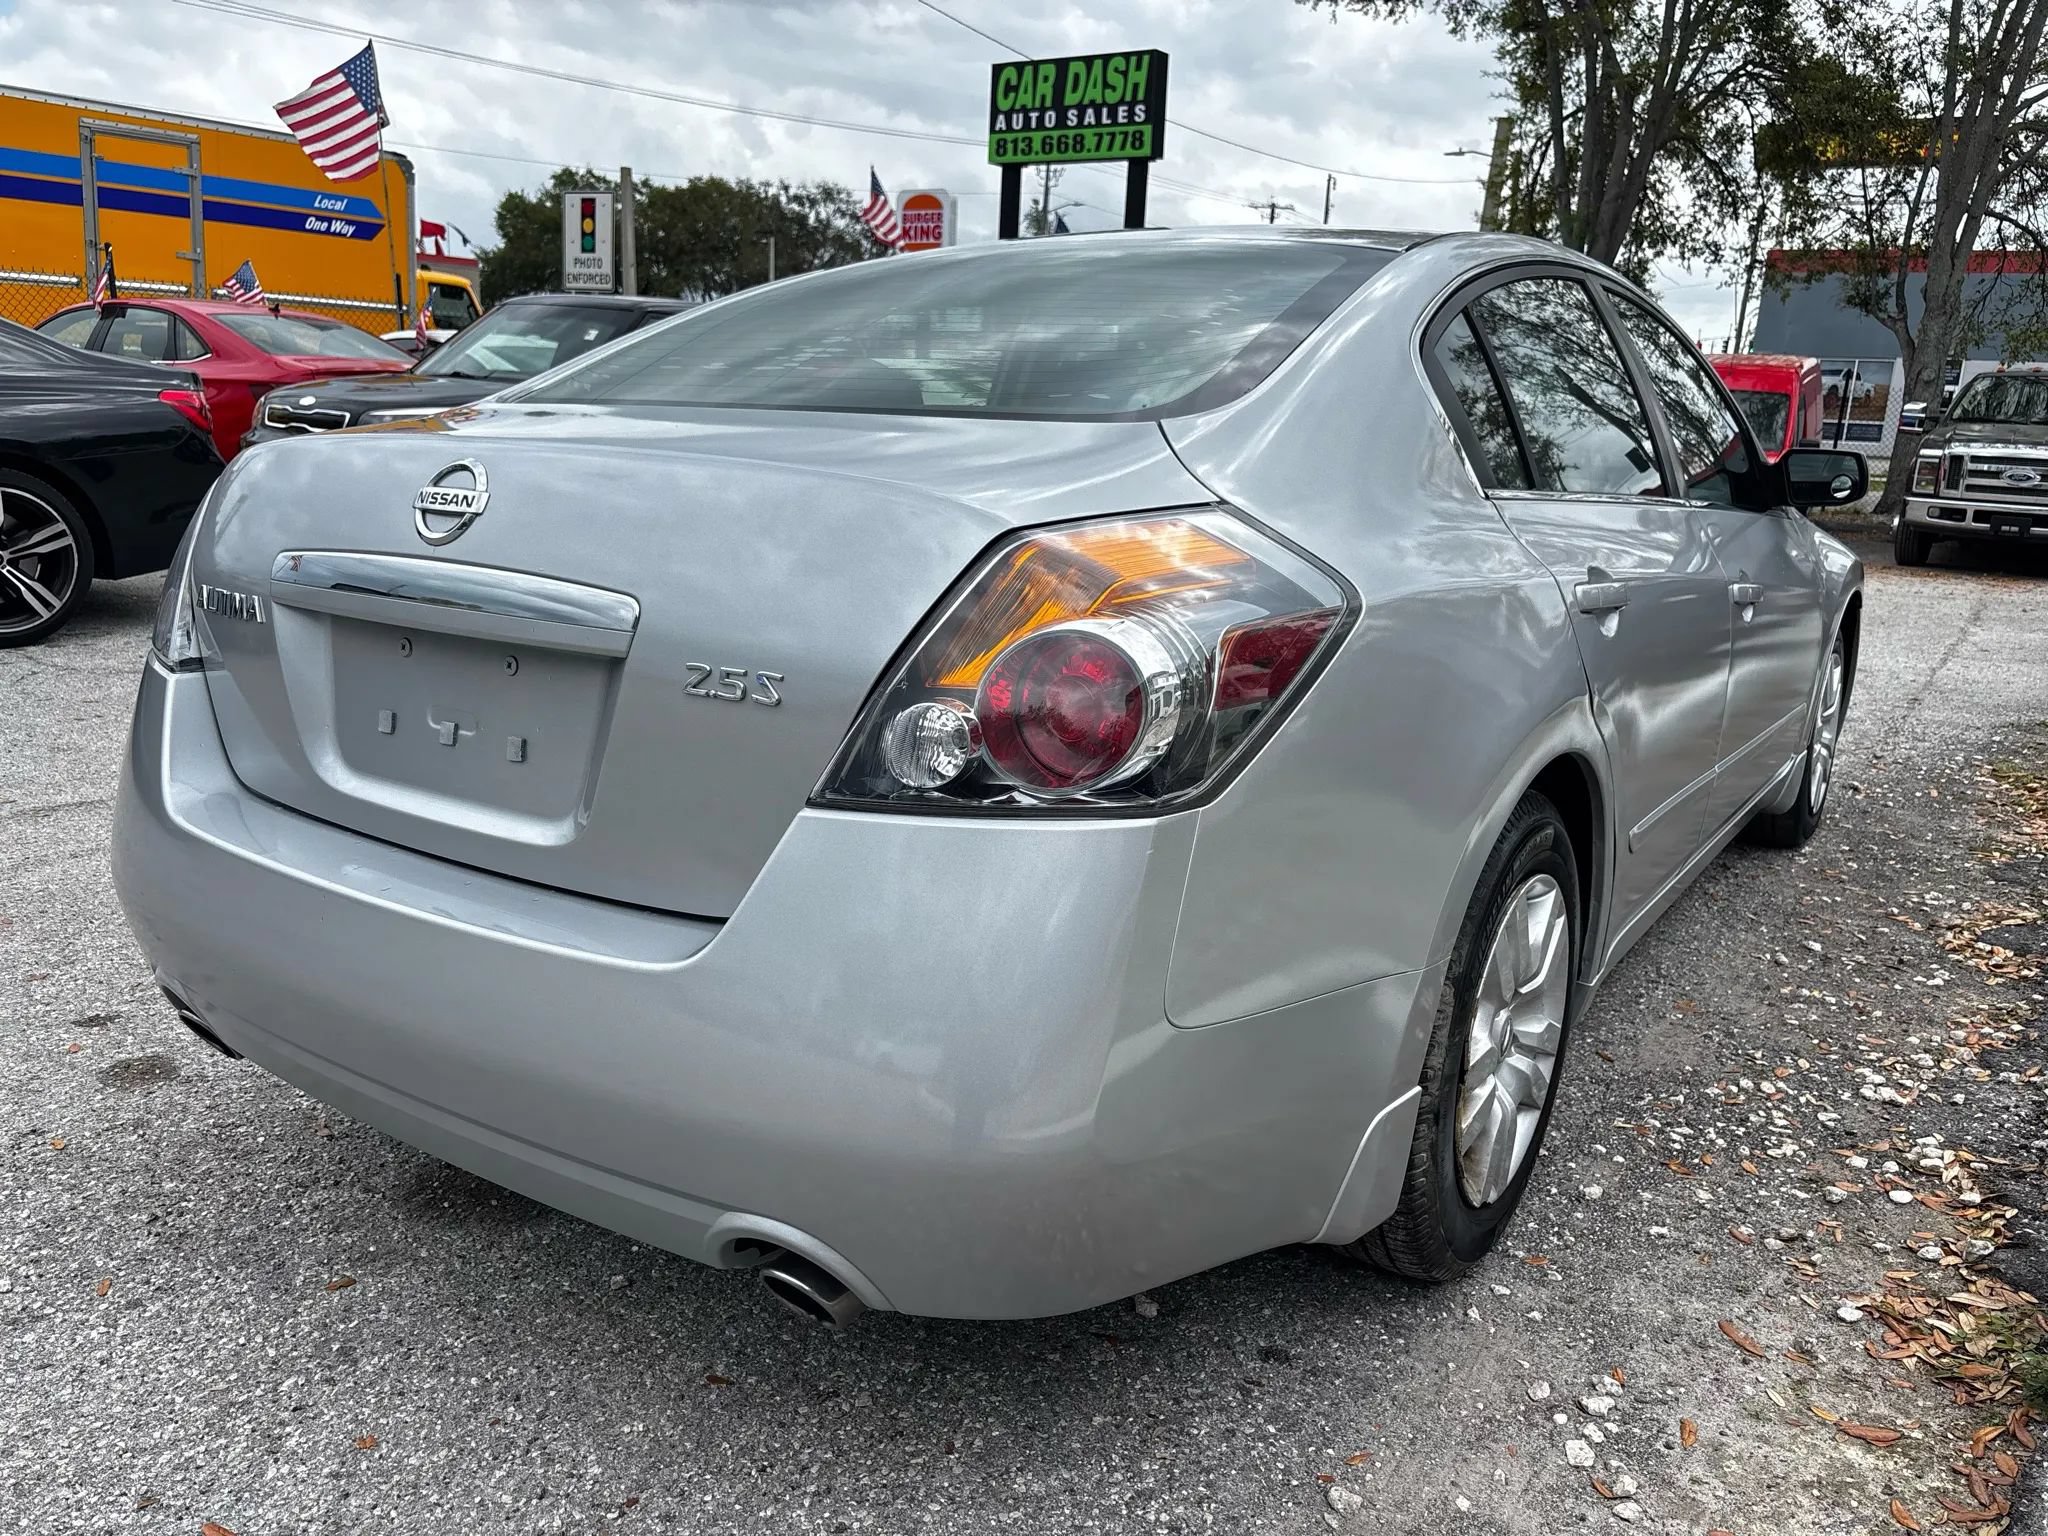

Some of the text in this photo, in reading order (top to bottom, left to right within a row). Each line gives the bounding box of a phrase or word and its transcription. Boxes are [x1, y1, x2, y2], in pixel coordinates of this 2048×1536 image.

[996, 54, 1150, 112] CAR DASH
[994, 104, 1147, 131] AUTO SALES
[995, 129, 1145, 158] 813.668.7778
[314, 194, 348, 211] Local
[304, 215, 357, 238] One Way
[903, 212, 943, 224] BURGER
[902, 224, 943, 242] KING
[574, 257, 603, 269] PHOTO
[567, 272, 611, 285] ENFORCED
[417, 491, 476, 508] NISSAN
[682, 662, 785, 707] 2.5 S
